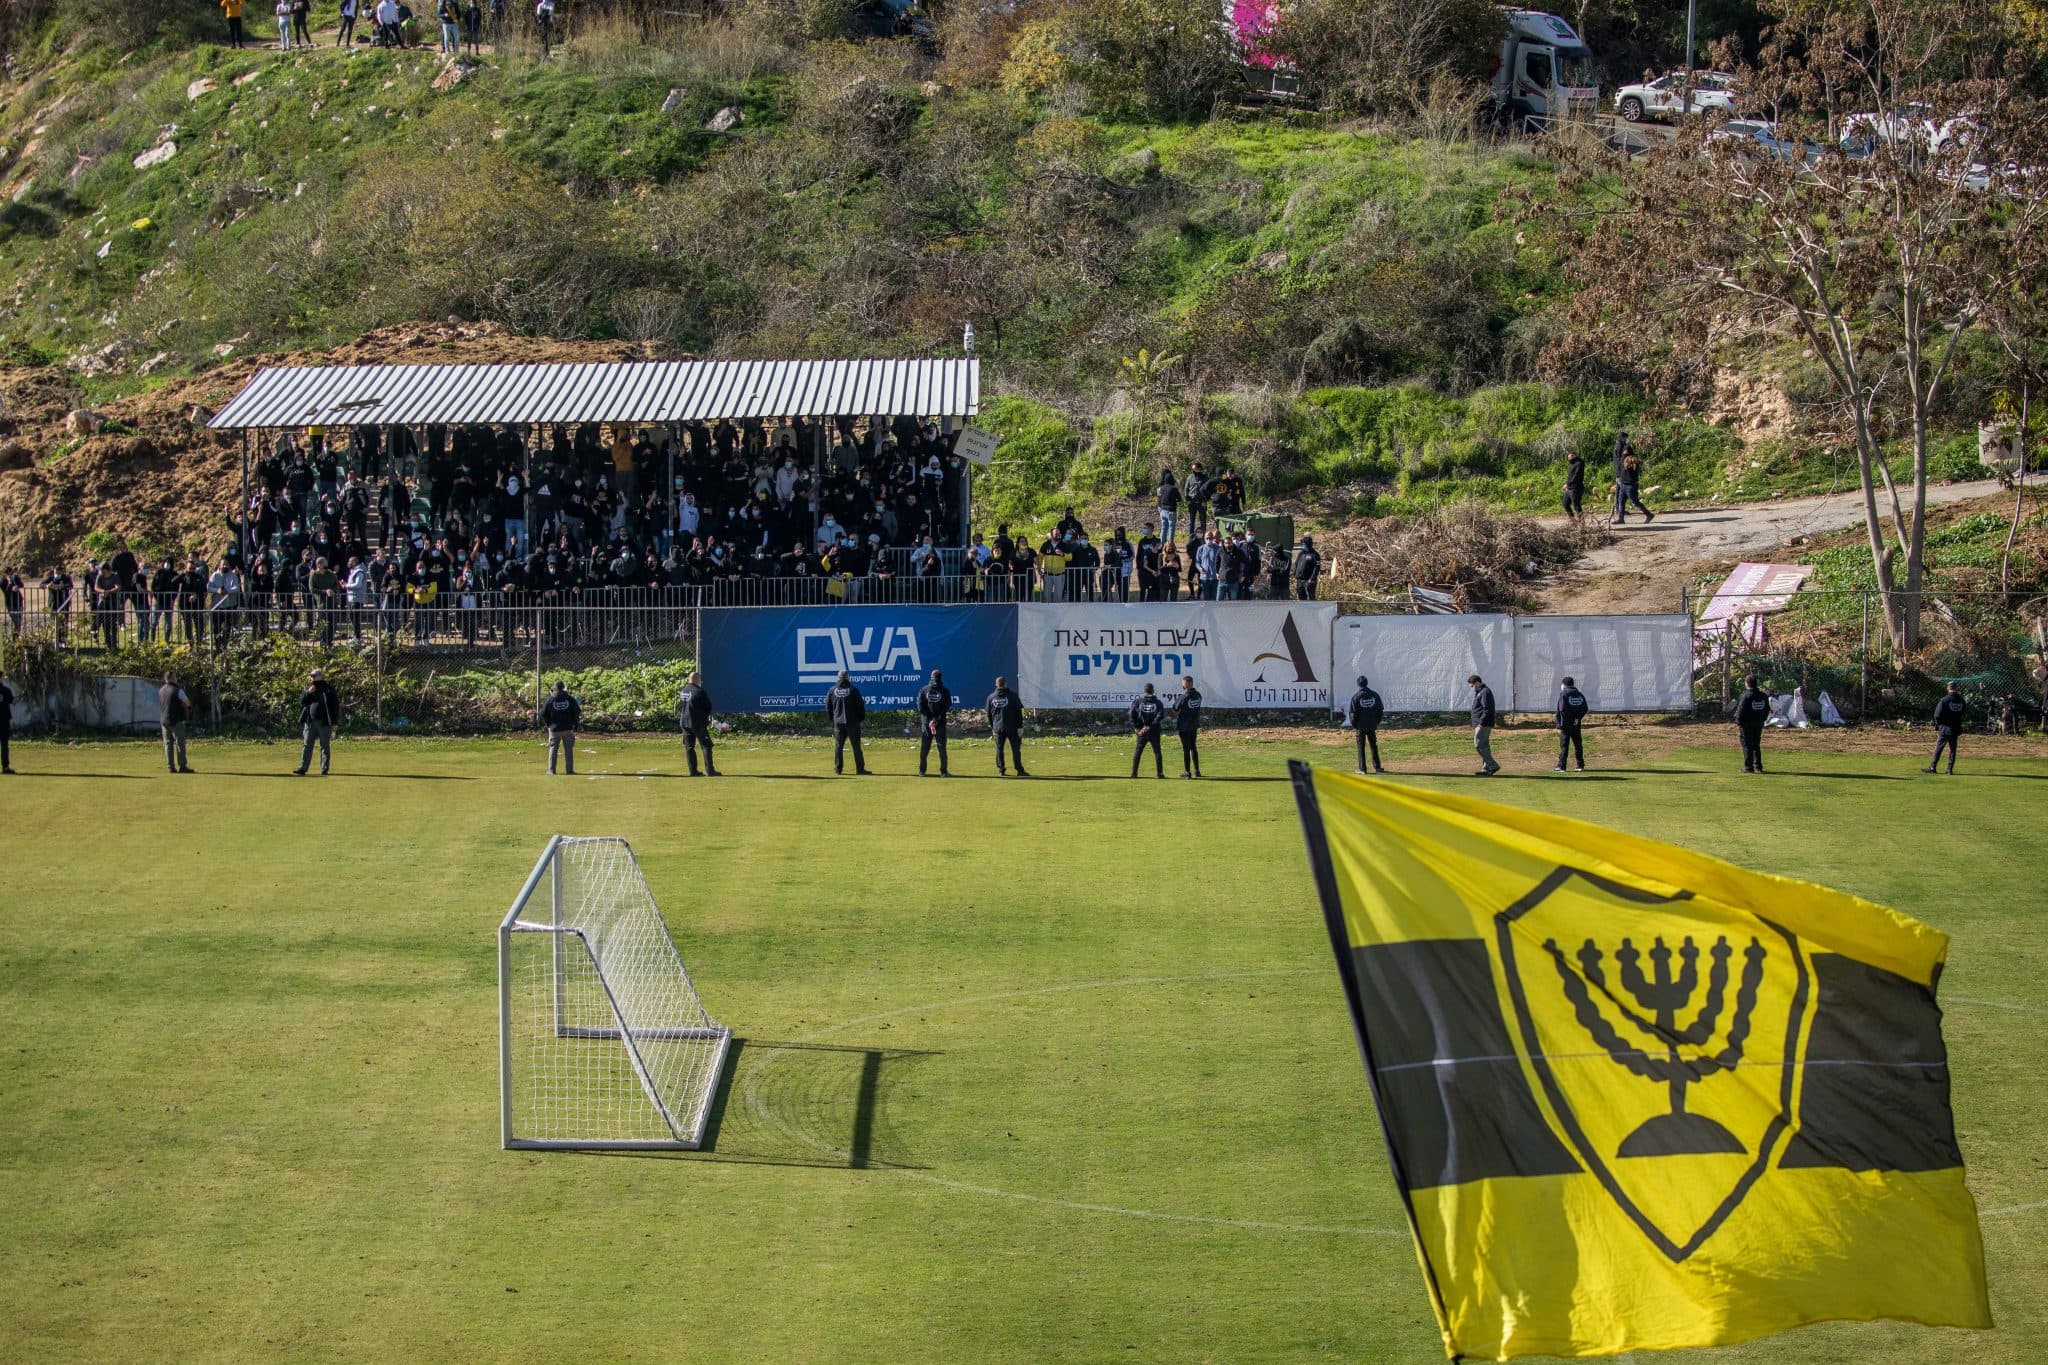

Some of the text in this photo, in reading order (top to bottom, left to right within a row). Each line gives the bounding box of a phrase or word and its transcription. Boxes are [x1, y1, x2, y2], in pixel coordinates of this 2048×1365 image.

[1053, 629, 1208, 647] גשם בונה את
[797, 627, 921, 672] גשם
[1068, 651, 1193, 675] ירושלים
[1282, 688, 1327, 702] ארנונה
